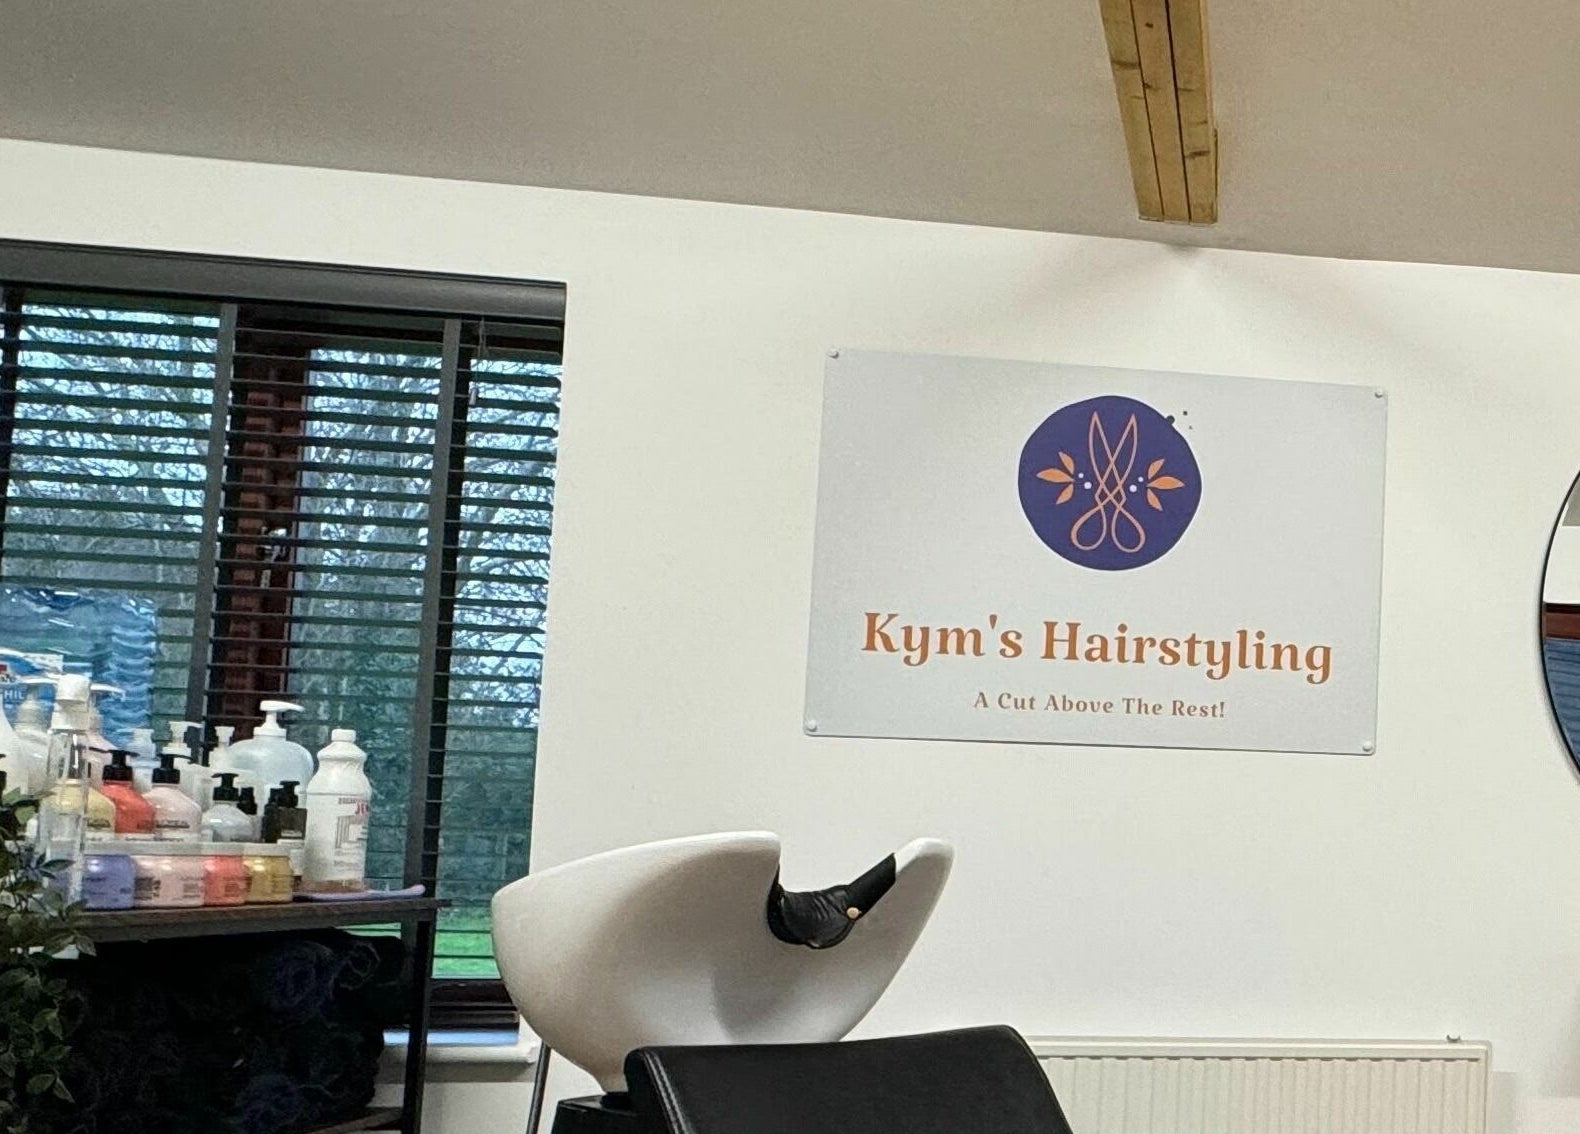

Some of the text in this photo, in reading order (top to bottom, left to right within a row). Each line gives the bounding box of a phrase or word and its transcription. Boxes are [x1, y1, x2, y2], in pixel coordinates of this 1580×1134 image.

[860, 611, 1332, 685] Kym's Hairstyling
[973, 691, 1225, 719] A Cut Above The Rest!
